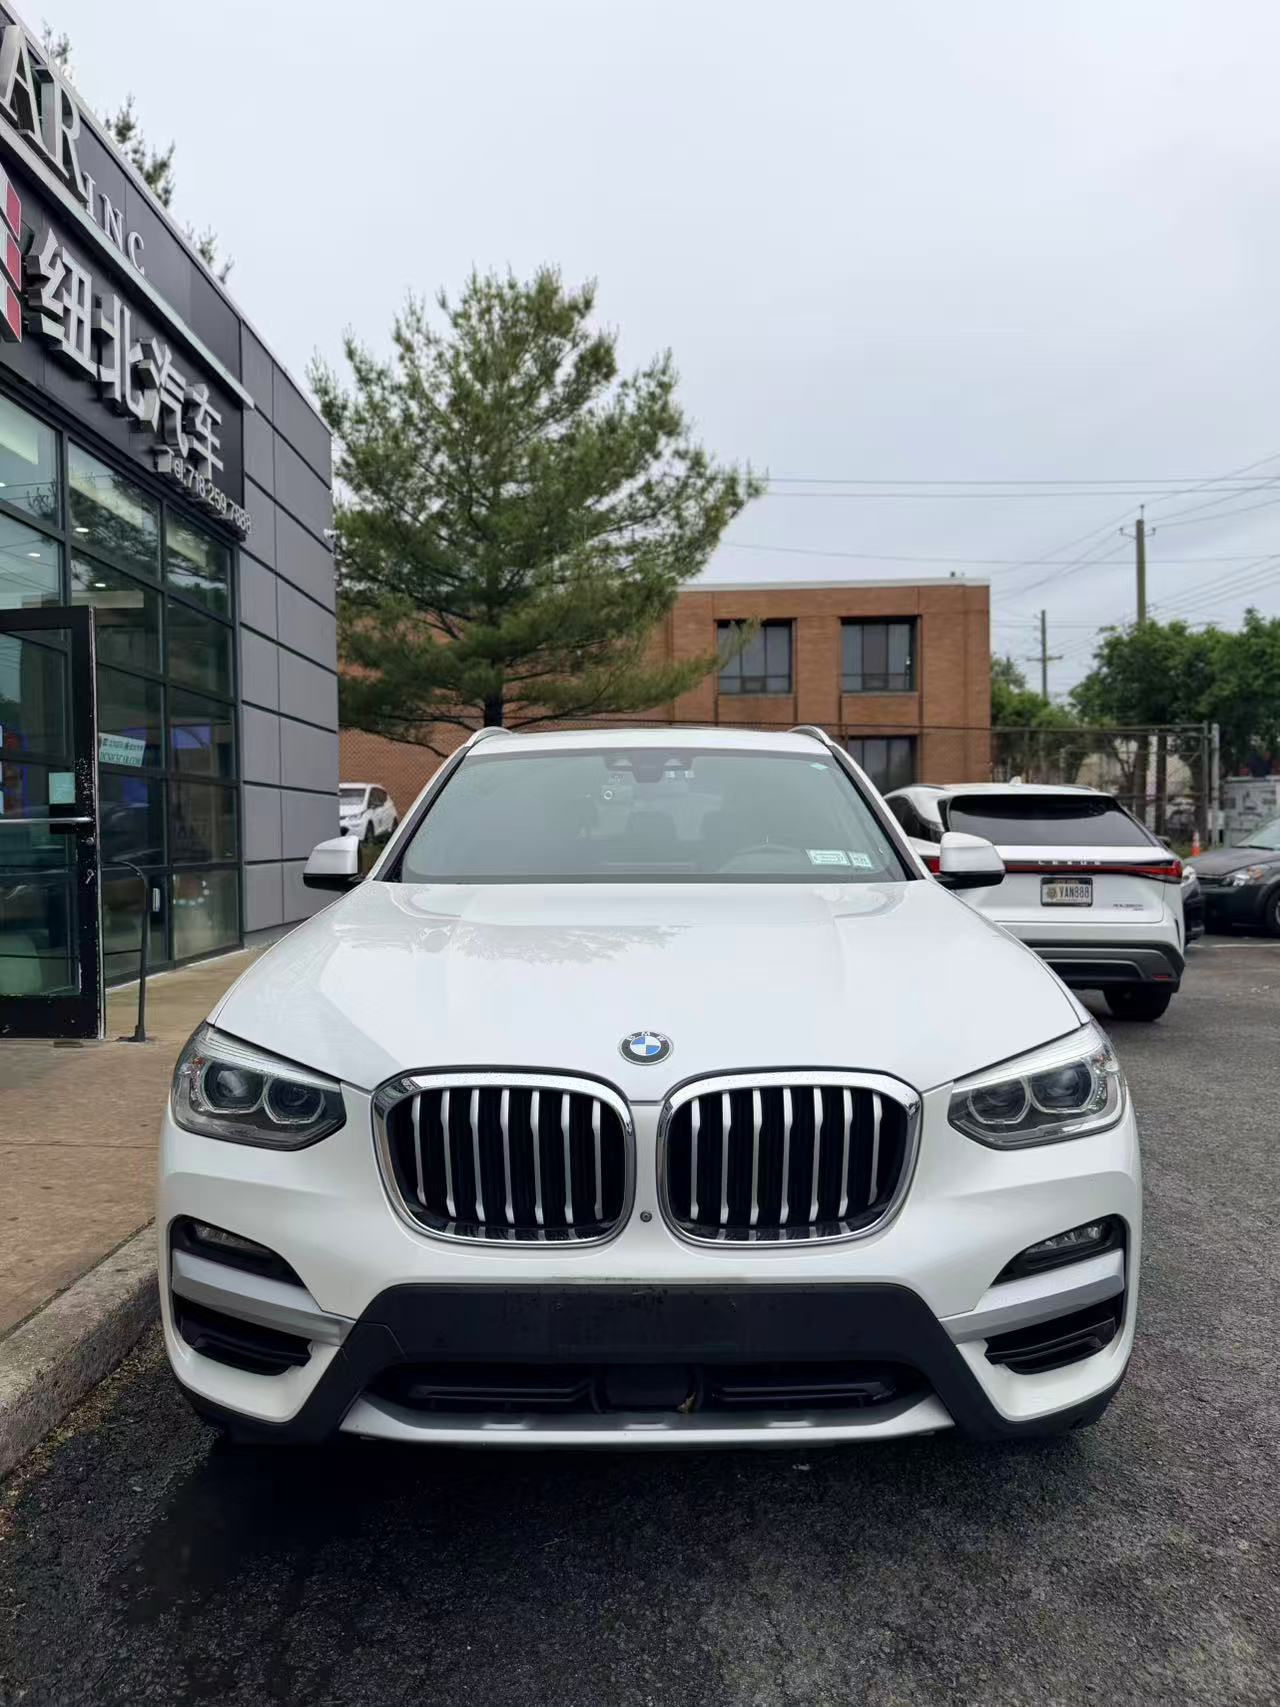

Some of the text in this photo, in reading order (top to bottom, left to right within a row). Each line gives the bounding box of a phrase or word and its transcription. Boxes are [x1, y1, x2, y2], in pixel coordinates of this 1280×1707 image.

[83, 171, 145, 276] INC
[34, 227, 224, 481] 纽北汽车
